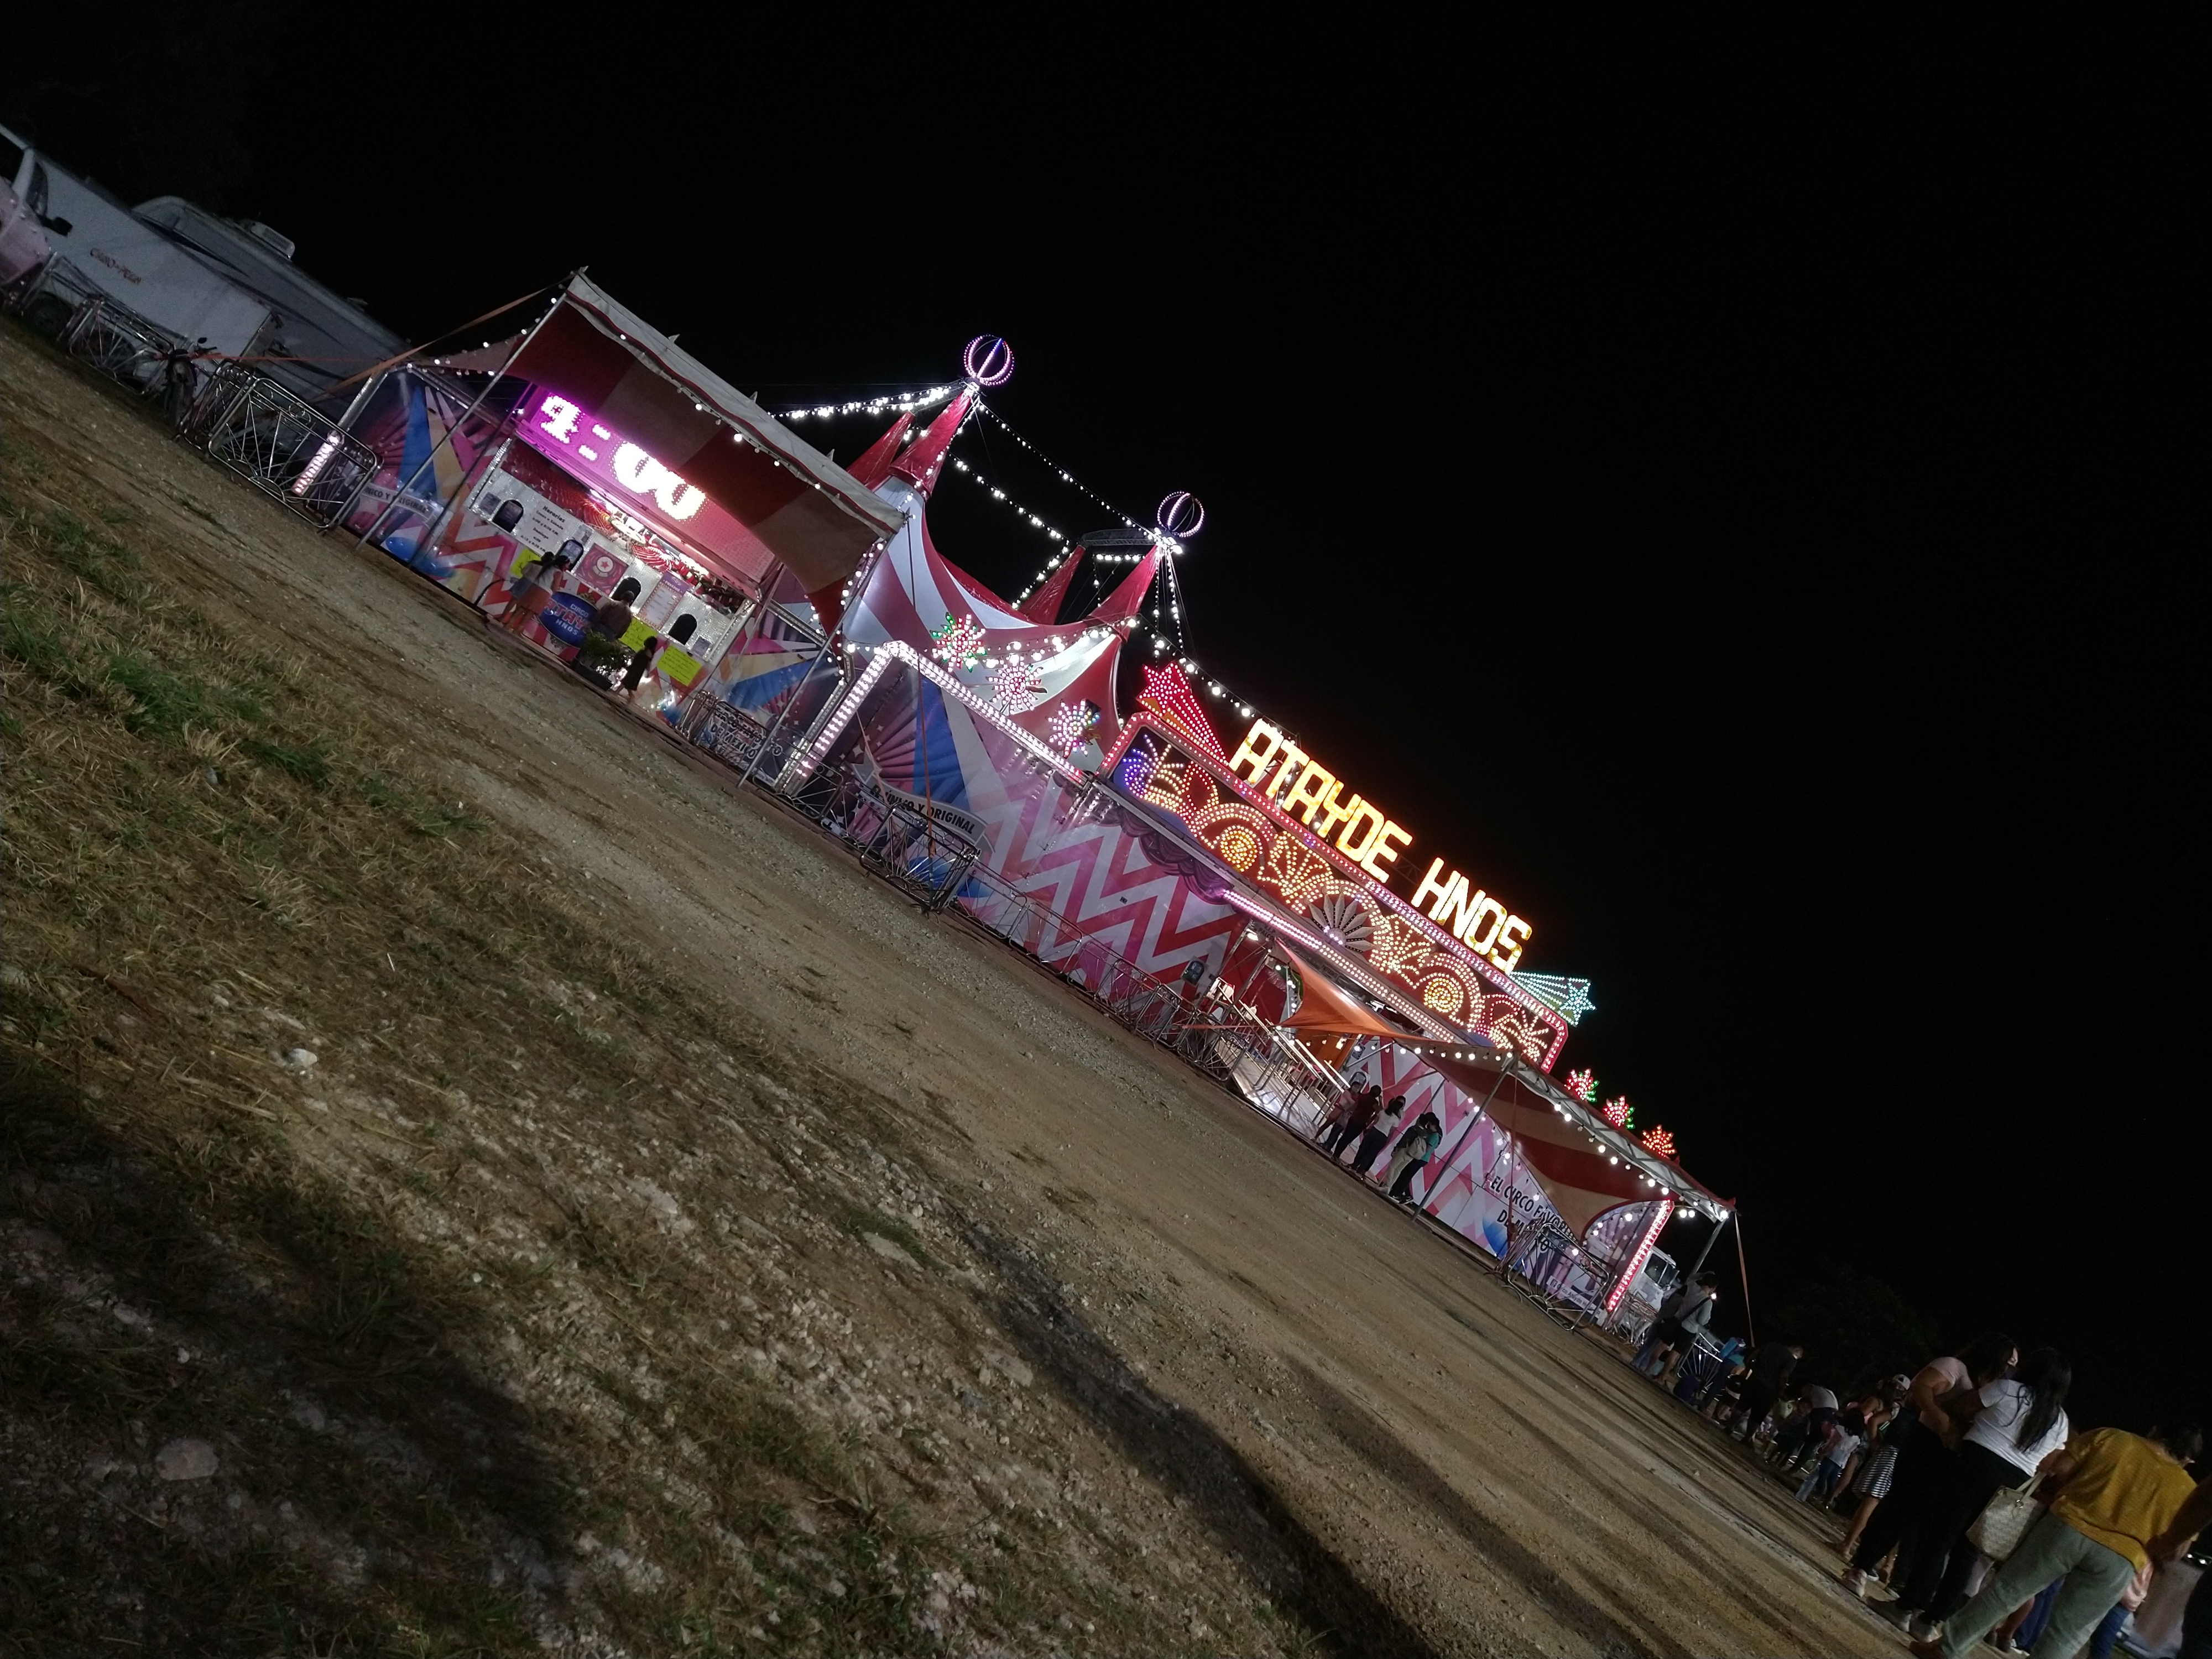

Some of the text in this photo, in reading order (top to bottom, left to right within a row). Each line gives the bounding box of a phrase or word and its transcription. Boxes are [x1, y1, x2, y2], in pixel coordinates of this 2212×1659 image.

[542, 505, 565, 523] Horarios
[570, 603, 589, 618] CIRCO
[555, 619, 578, 635] HNOS
[926, 807, 976, 835] ORIGINAL
[1228, 718, 1533, 976] ATAYDE HNOS
[1490, 1176, 1504, 1193] EL
[1504, 1185, 1535, 1212] CIRCO
